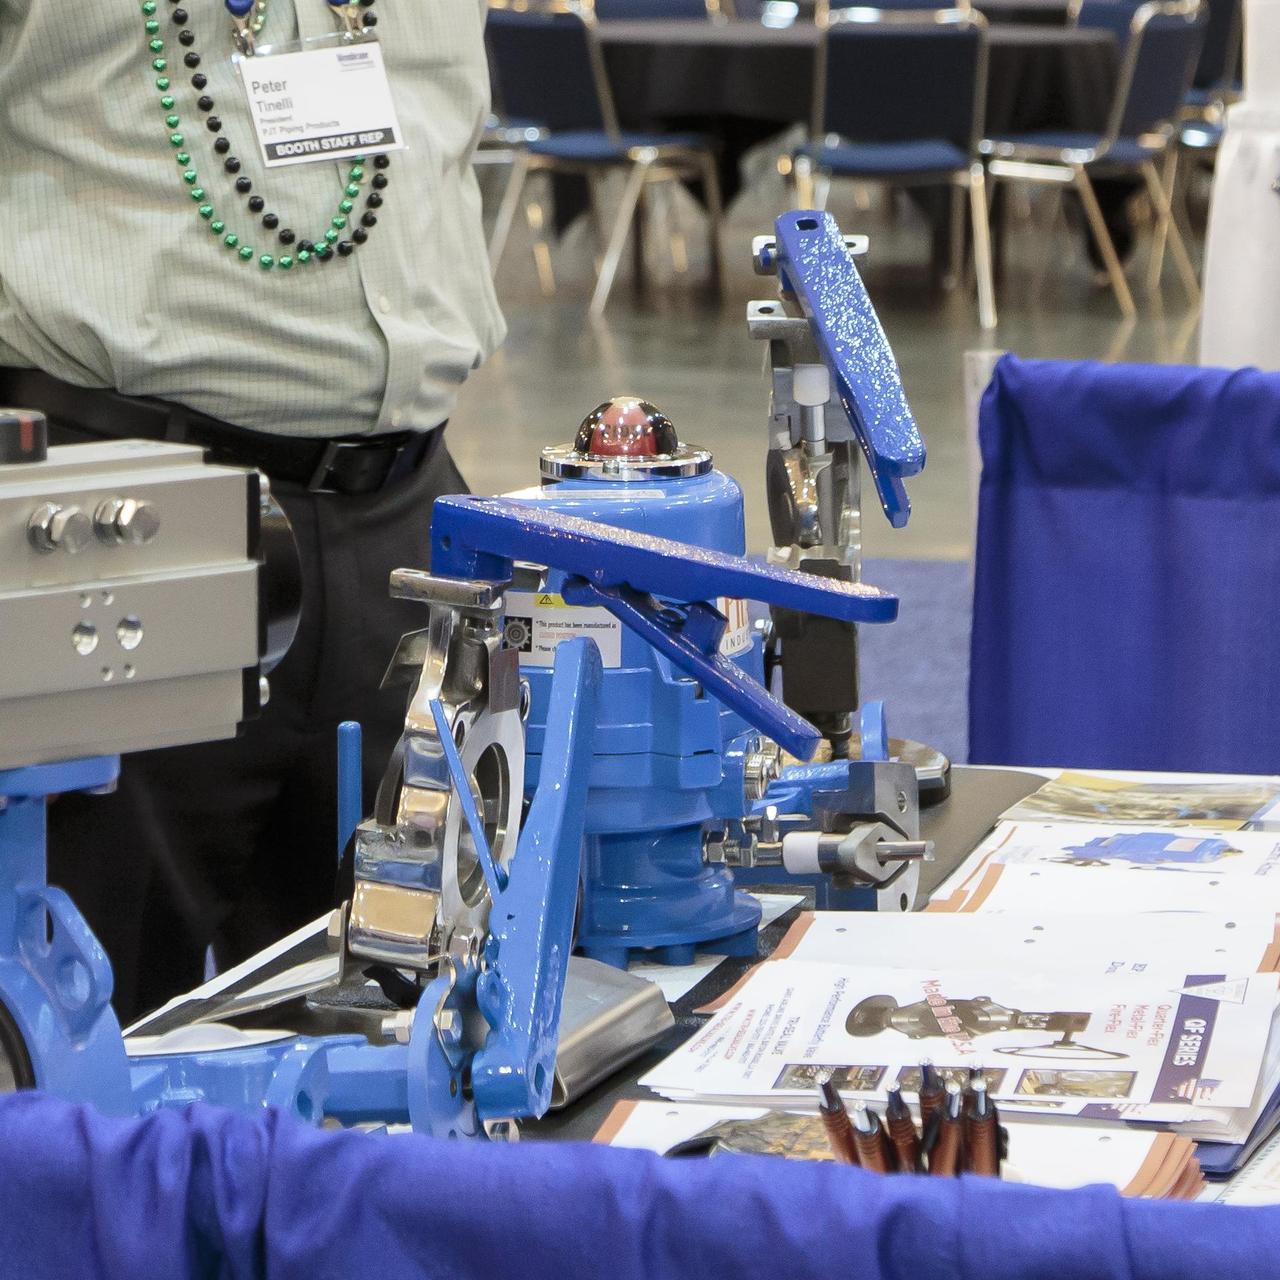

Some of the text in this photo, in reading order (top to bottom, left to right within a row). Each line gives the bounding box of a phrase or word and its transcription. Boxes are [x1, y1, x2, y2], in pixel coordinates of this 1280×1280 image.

[251, 79, 288, 95] Peter
[256, 97, 293, 113] Tinelli
[275, 131, 384, 156] BOOTH STAFF REP
[920, 979, 948, 1007] Made
[1173, 1034, 1204, 1066] SERIES
